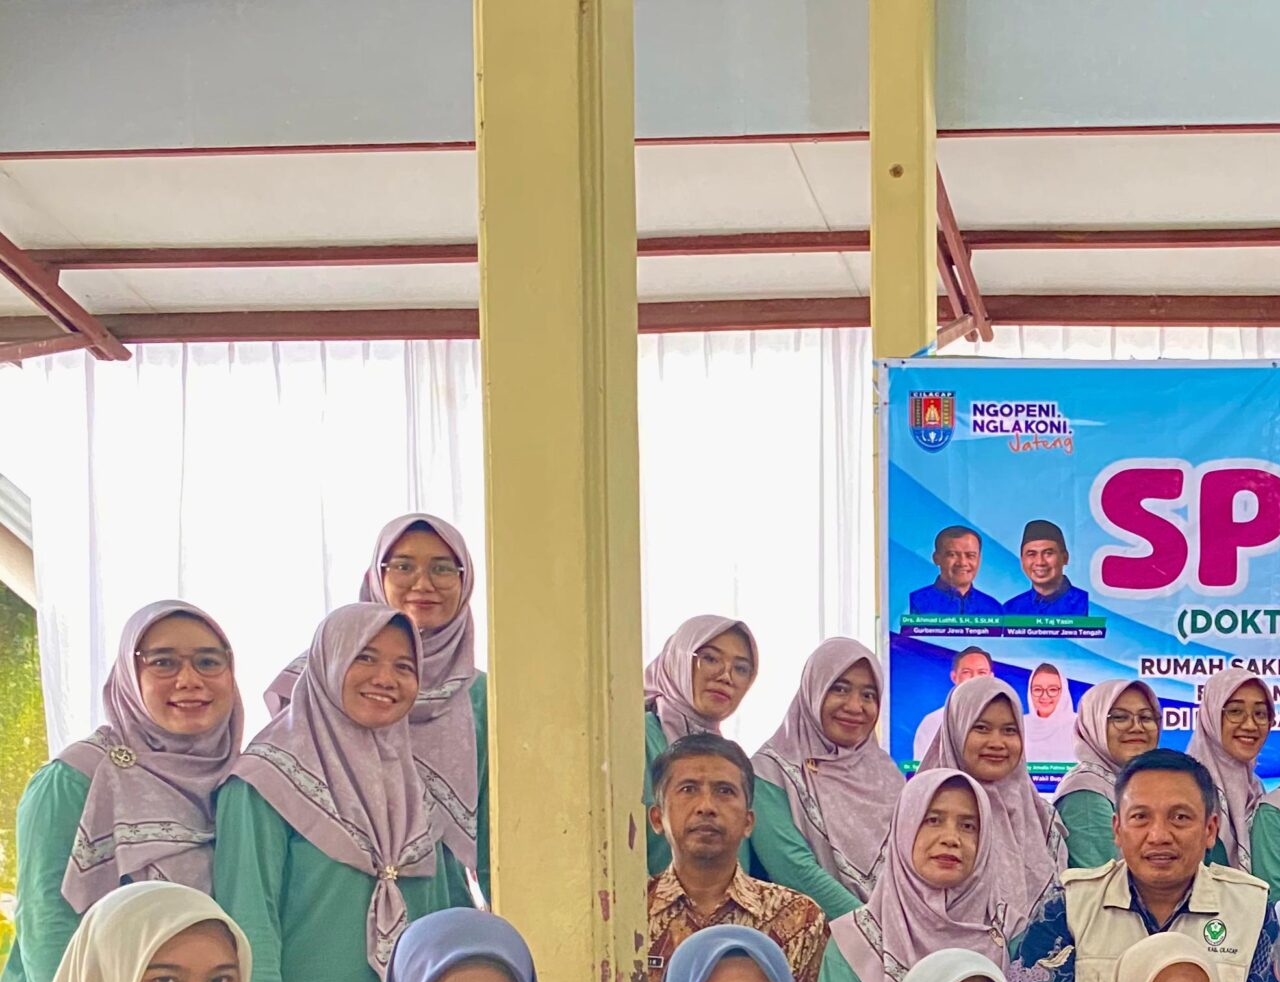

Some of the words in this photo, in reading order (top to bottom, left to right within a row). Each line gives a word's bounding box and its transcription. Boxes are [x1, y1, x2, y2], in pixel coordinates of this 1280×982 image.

[972, 404, 1061, 418] NGOPENI.
[972, 420, 1073, 434] NGLAKONI.
[1008, 433, 1073, 454] Jateng
[1141, 658, 1223, 675] RUMAH
[1166, 711, 1187, 727] DI
